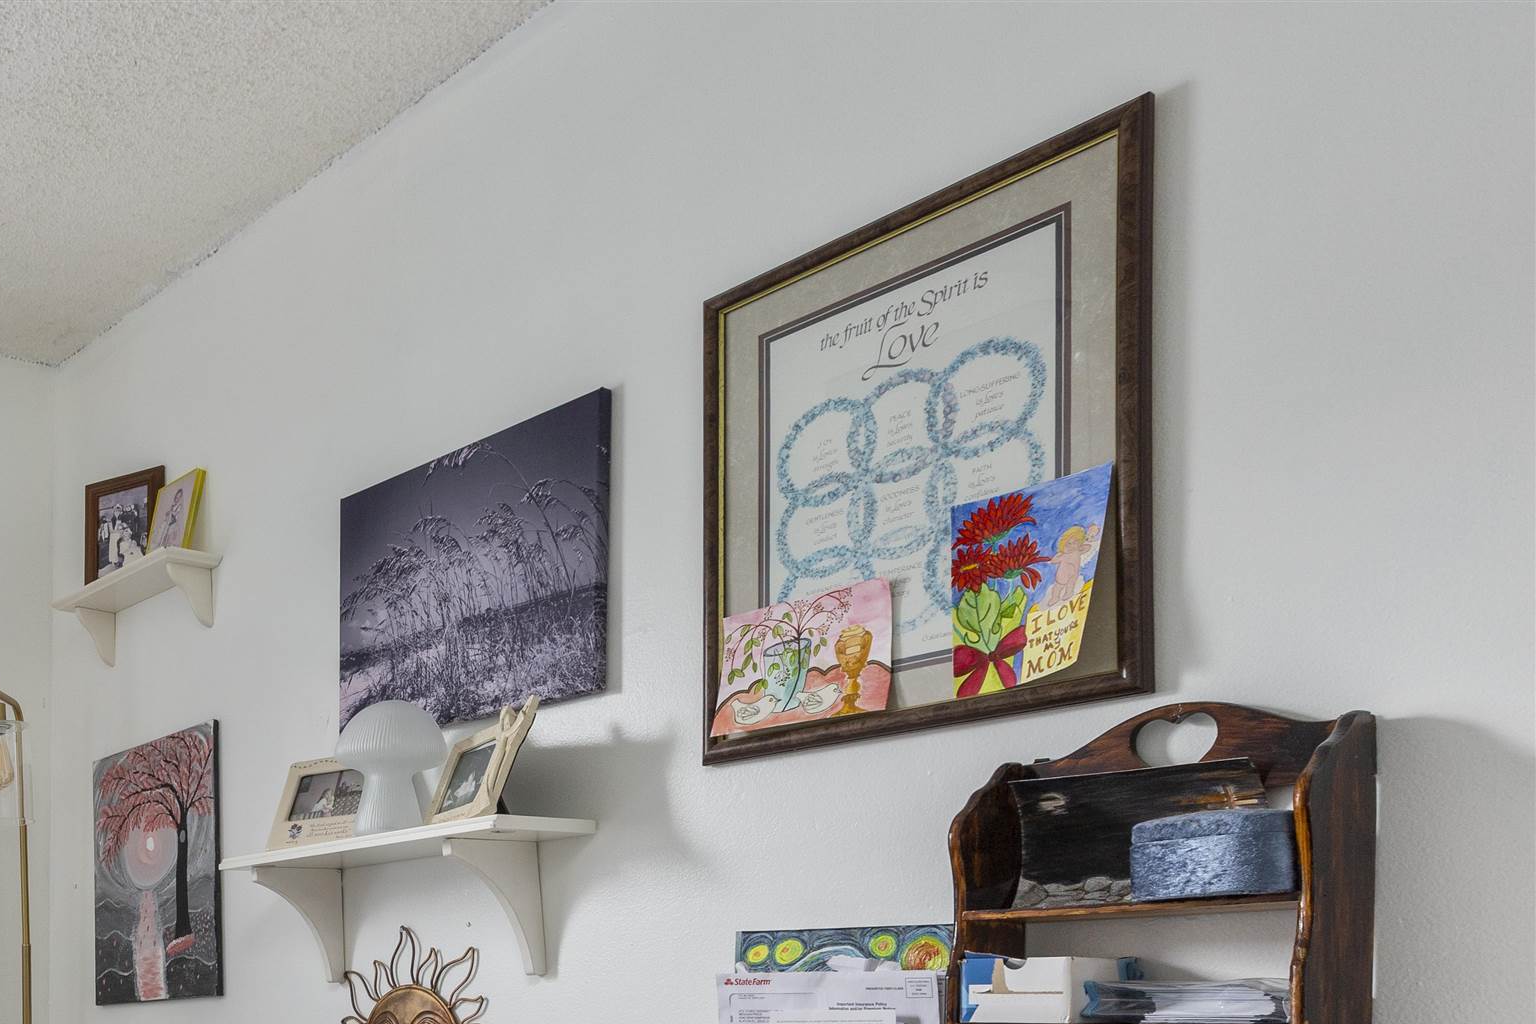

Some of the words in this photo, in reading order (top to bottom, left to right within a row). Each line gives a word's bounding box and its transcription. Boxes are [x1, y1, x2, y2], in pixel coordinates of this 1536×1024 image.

[820, 333, 839, 351] the
[840, 317, 873, 349] fruit
[876, 304, 894, 332] of
[894, 301, 915, 322] the
[917, 279, 968, 317] Spirit
[973, 271, 989, 290] is
[861, 319, 939, 381] Love
[1032, 614, 1042, 634] I
[1046, 593, 1087, 626] LOVE
[1026, 641, 1074, 678] MOM
